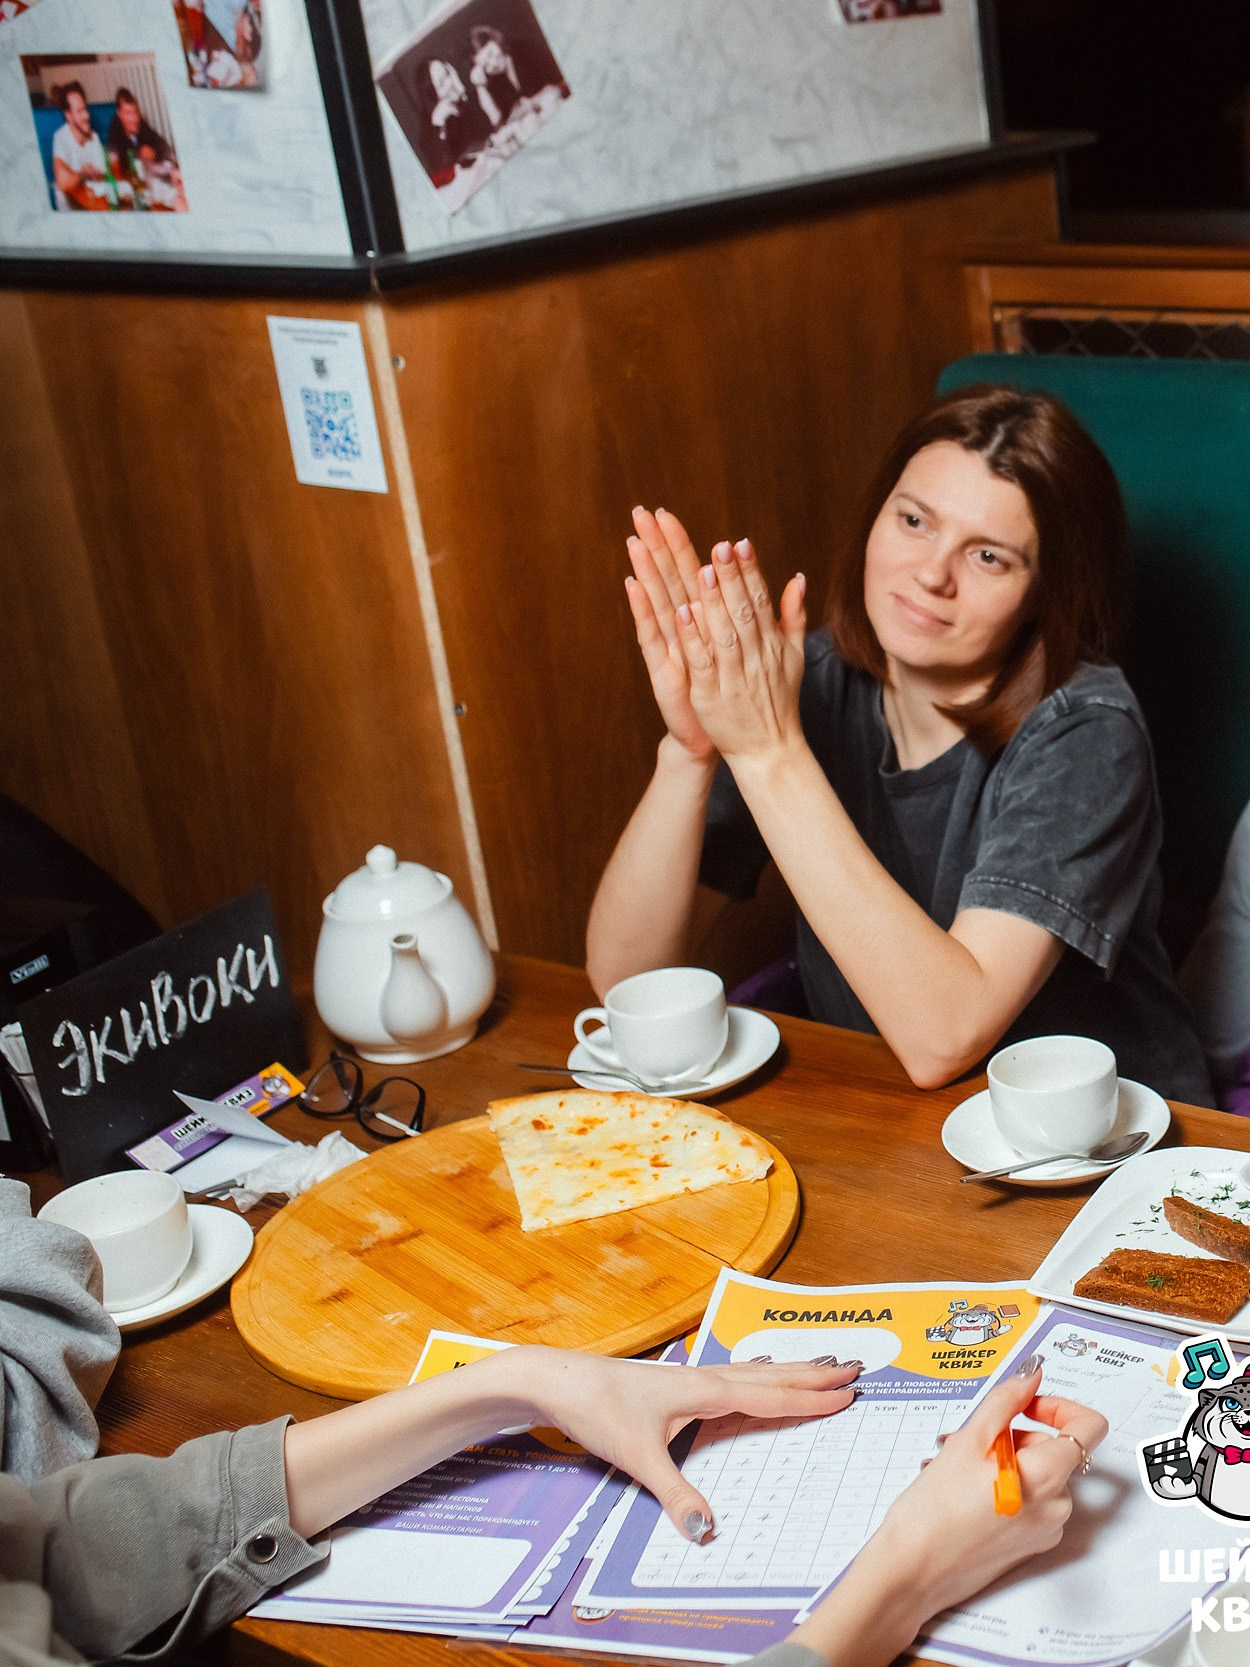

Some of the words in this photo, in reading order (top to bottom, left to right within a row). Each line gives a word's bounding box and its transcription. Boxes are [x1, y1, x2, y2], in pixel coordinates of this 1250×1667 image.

[52, 934, 280, 1097] ЭКИВОКИ
[173, 1116, 205, 1138] ШЕЙК
[763, 1308, 893, 1323] КОМАНДА
[931, 1348, 997, 1360] ШЕЙКЕР
[1100, 1347, 1145, 1364] ШЕЙКЕР
[939, 1360, 983, 1369] КВИЗ
[1095, 1355, 1126, 1368] КВИЗ
[854, 1380, 891, 1388] ОТОРЫЕ
[464, 1444, 485, 1453] АМ
[478, 1458, 533, 1471] пожалуйста,
[448, 1495, 489, 1504] РЕСТОРАНА
[443, 1503, 483, 1513] НАПИТКОВ
[395, 1521, 421, 1529] ВАШИ
